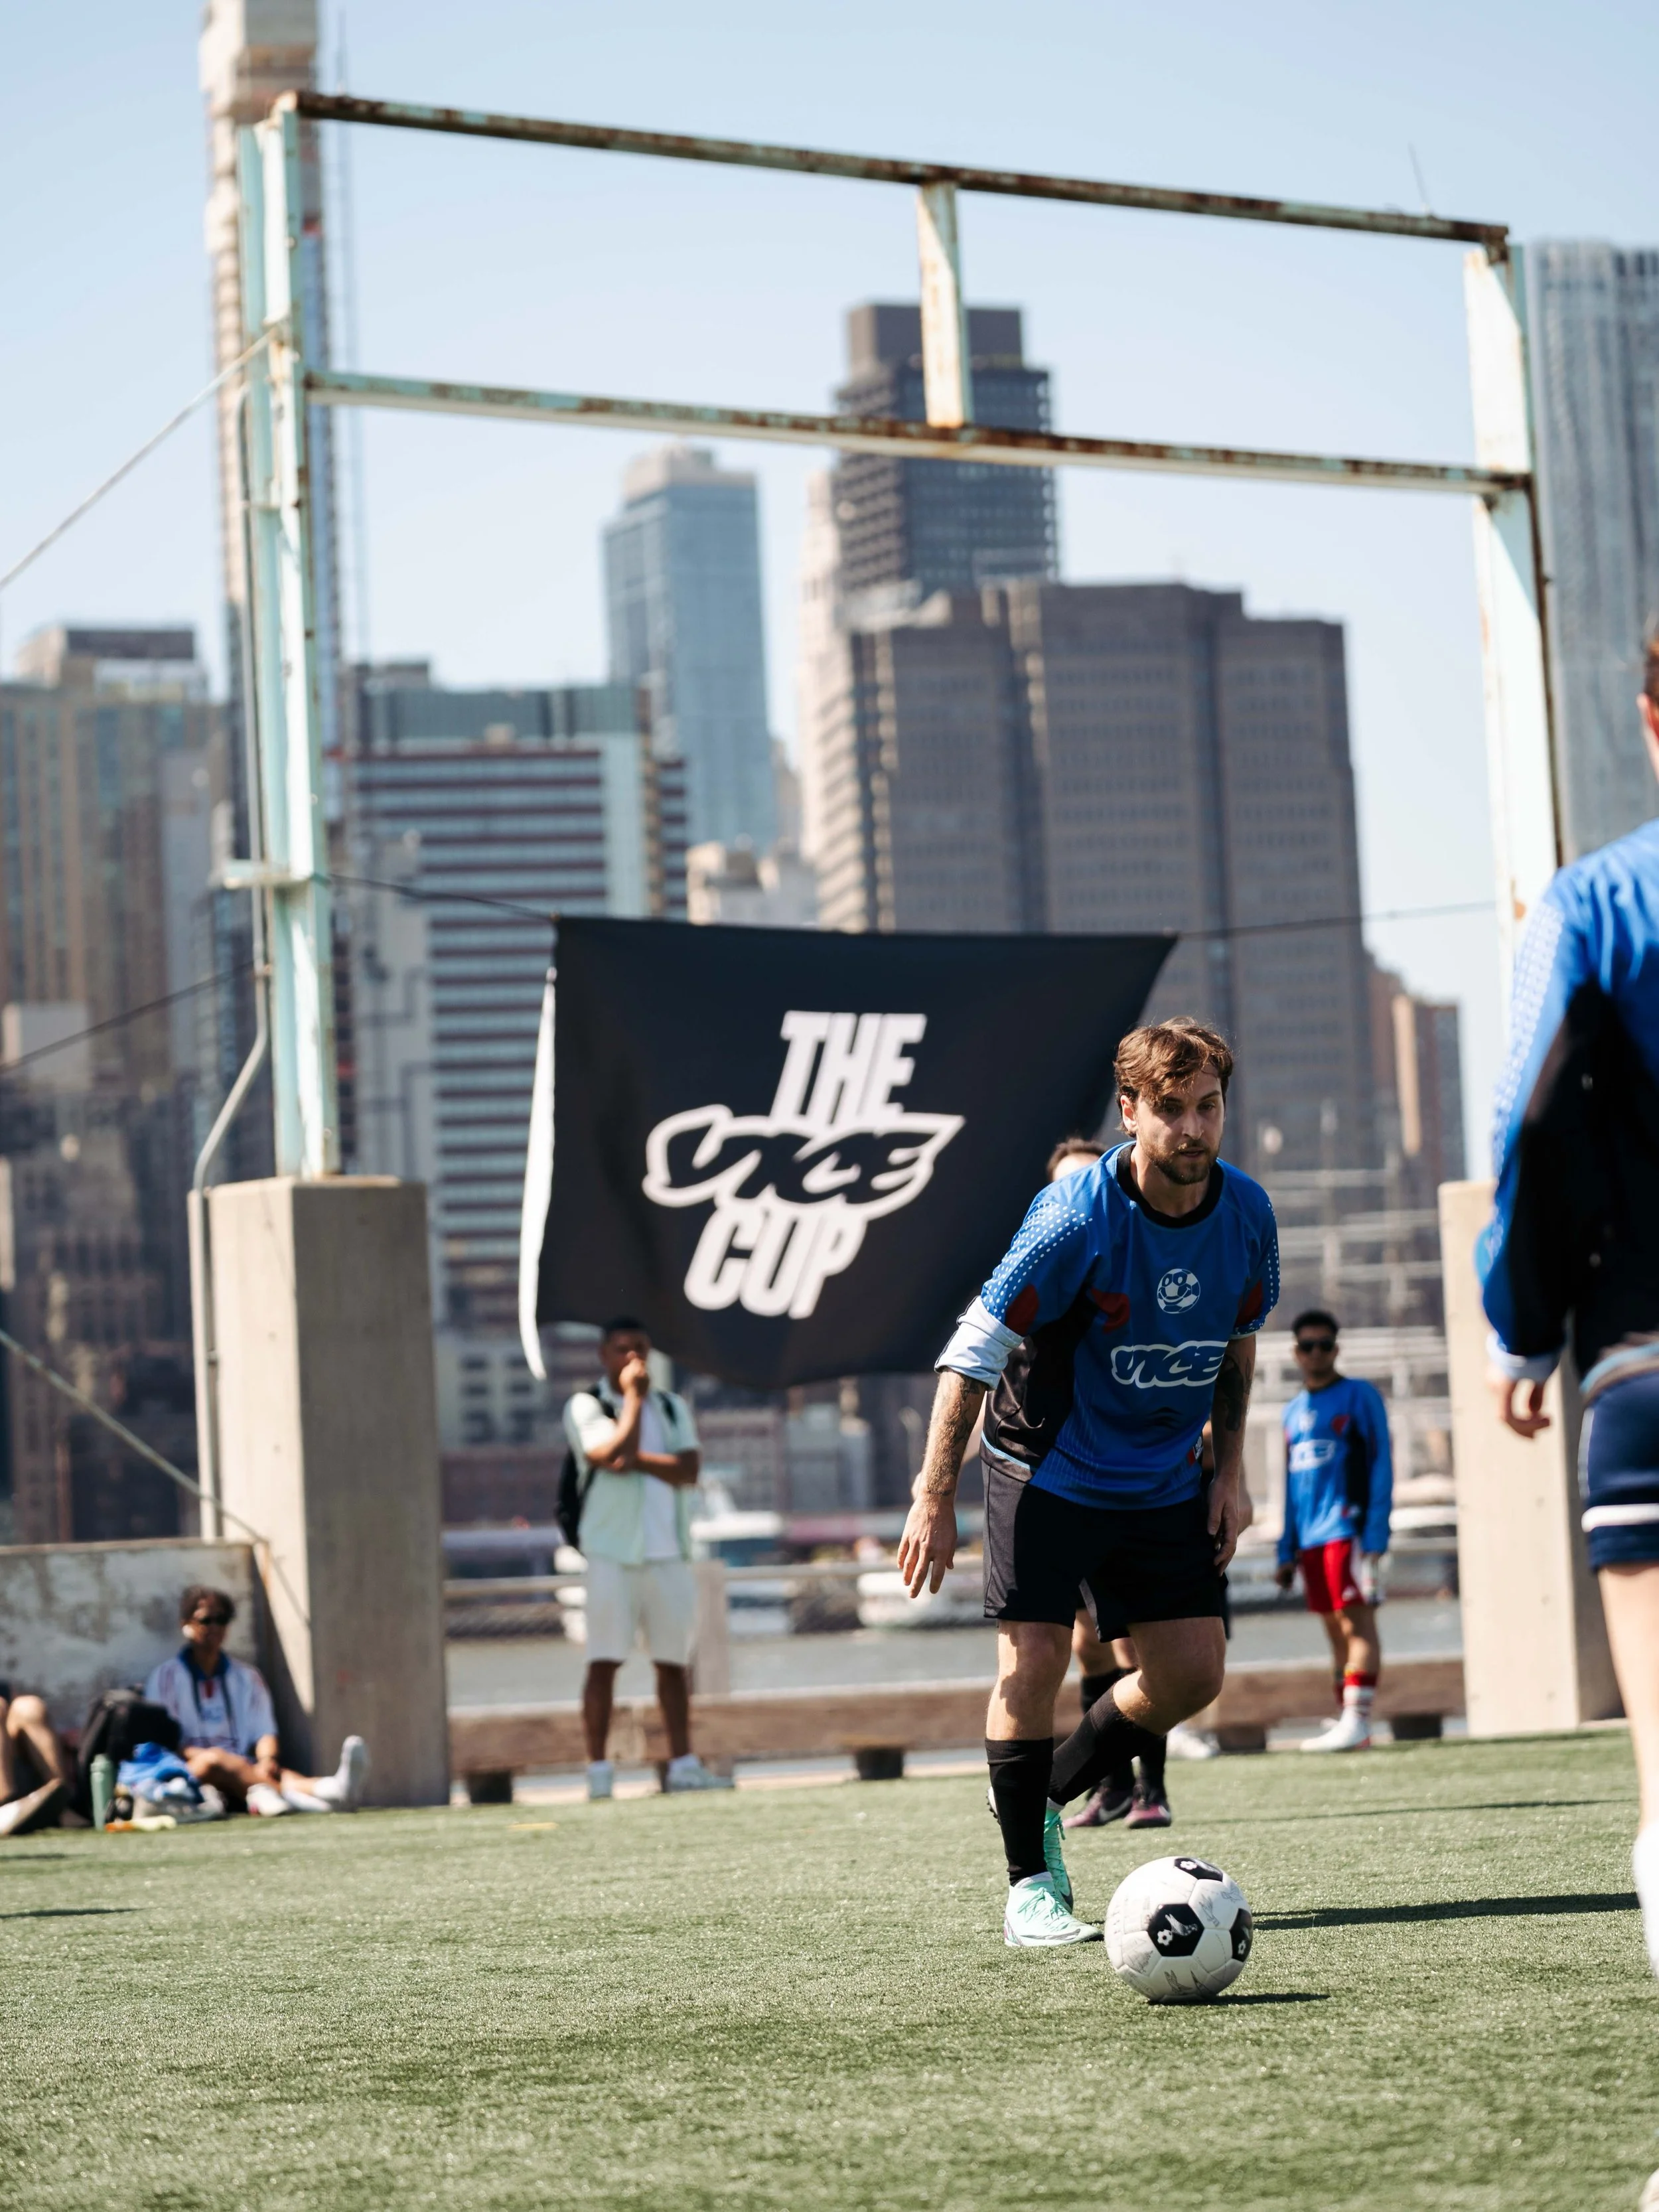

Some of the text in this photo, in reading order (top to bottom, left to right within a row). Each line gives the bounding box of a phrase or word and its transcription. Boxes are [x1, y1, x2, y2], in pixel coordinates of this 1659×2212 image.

[770, 1009, 927, 1122] THE
[642, 1104, 965, 1222] VICE
[684, 1205, 869, 1319] CUP
[1110, 1340, 1228, 1389] VICE
